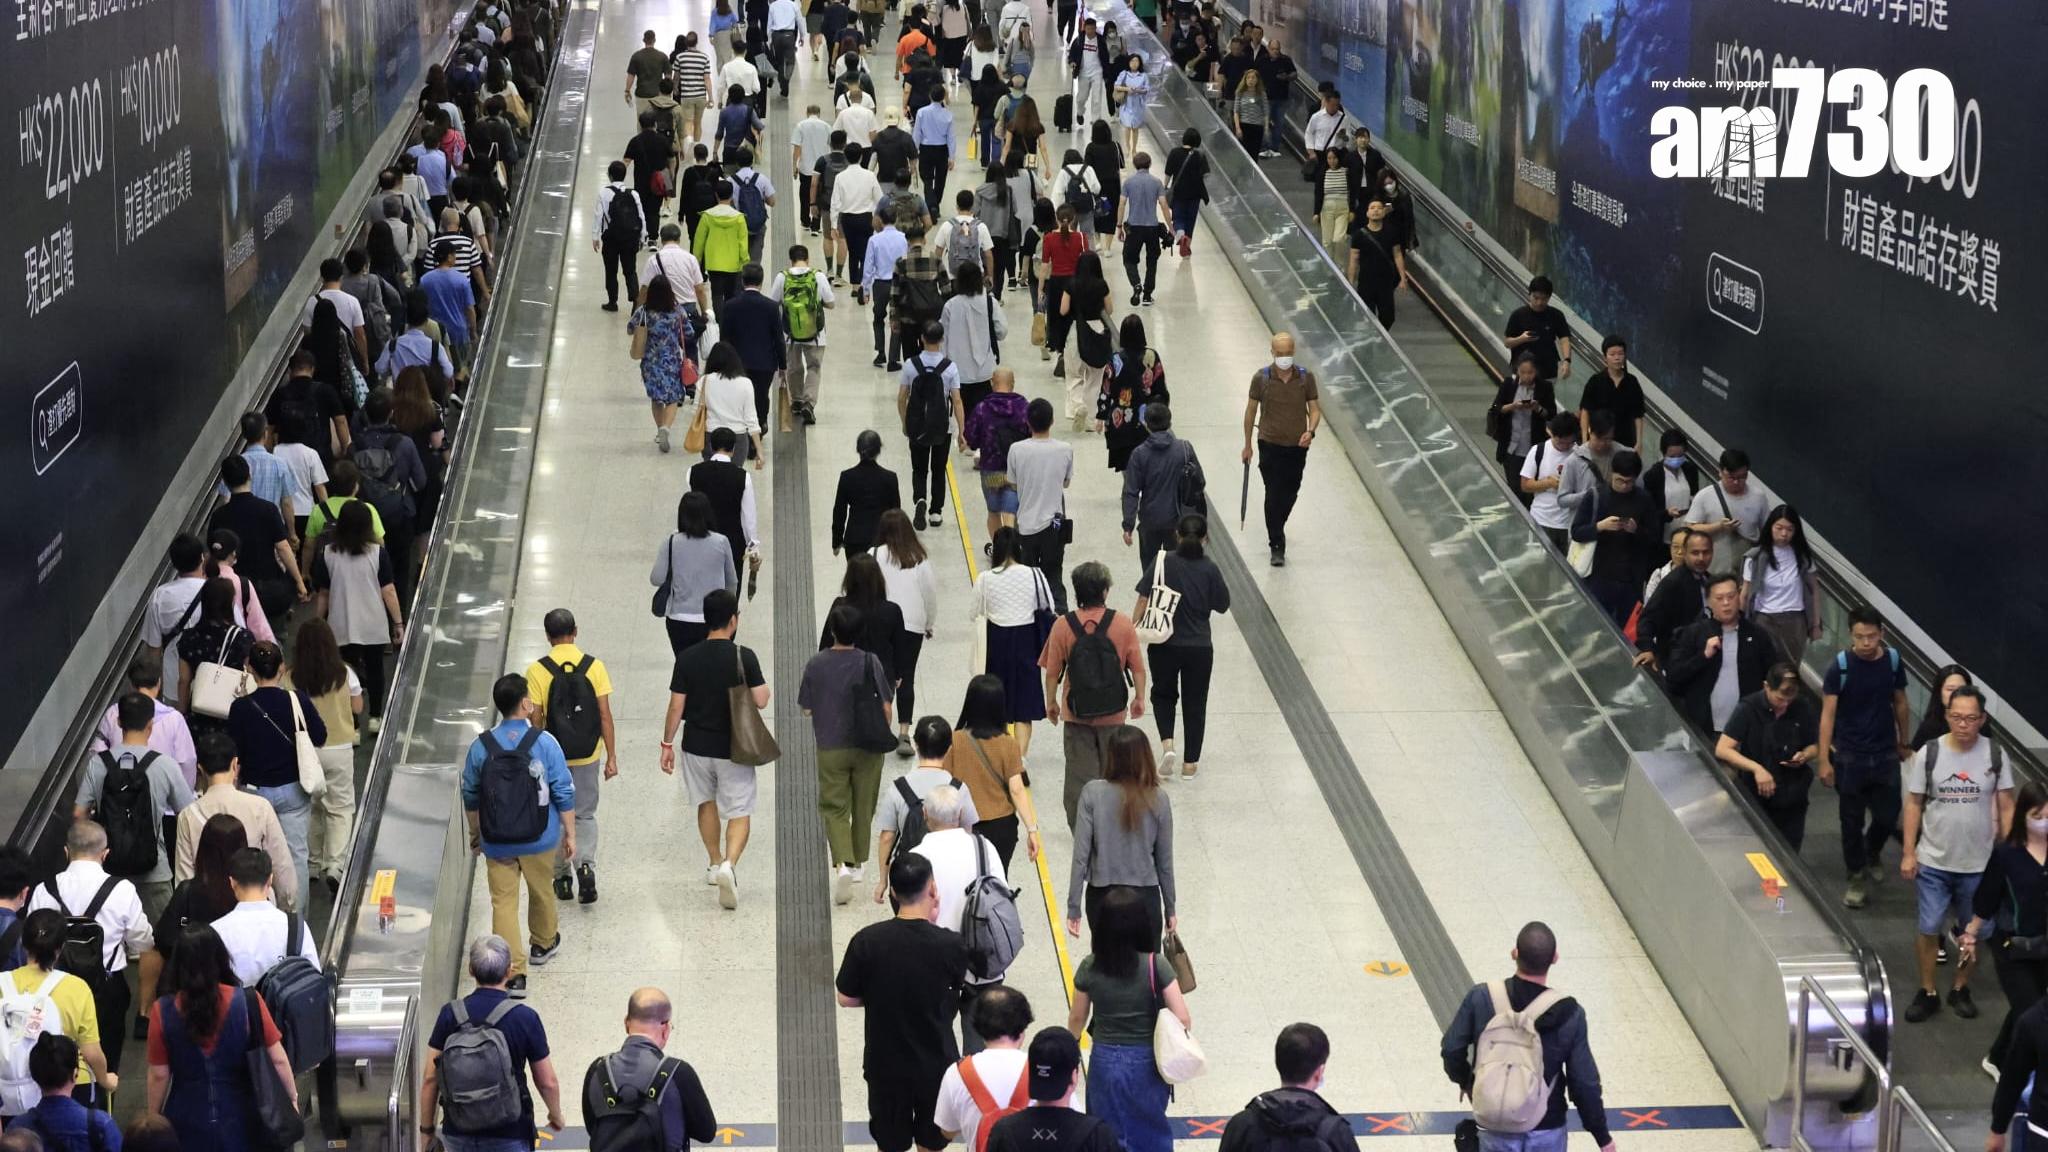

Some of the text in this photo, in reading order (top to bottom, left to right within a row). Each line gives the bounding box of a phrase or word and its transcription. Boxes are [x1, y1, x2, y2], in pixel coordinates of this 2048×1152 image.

[19, 77, 104, 204] HK$22,000
[25, 221, 74, 318] 現金回贈
[1842, 188, 2000, 312] 財富產品結存獎賞
[1938, 786, 1981, 794] WINNERS
